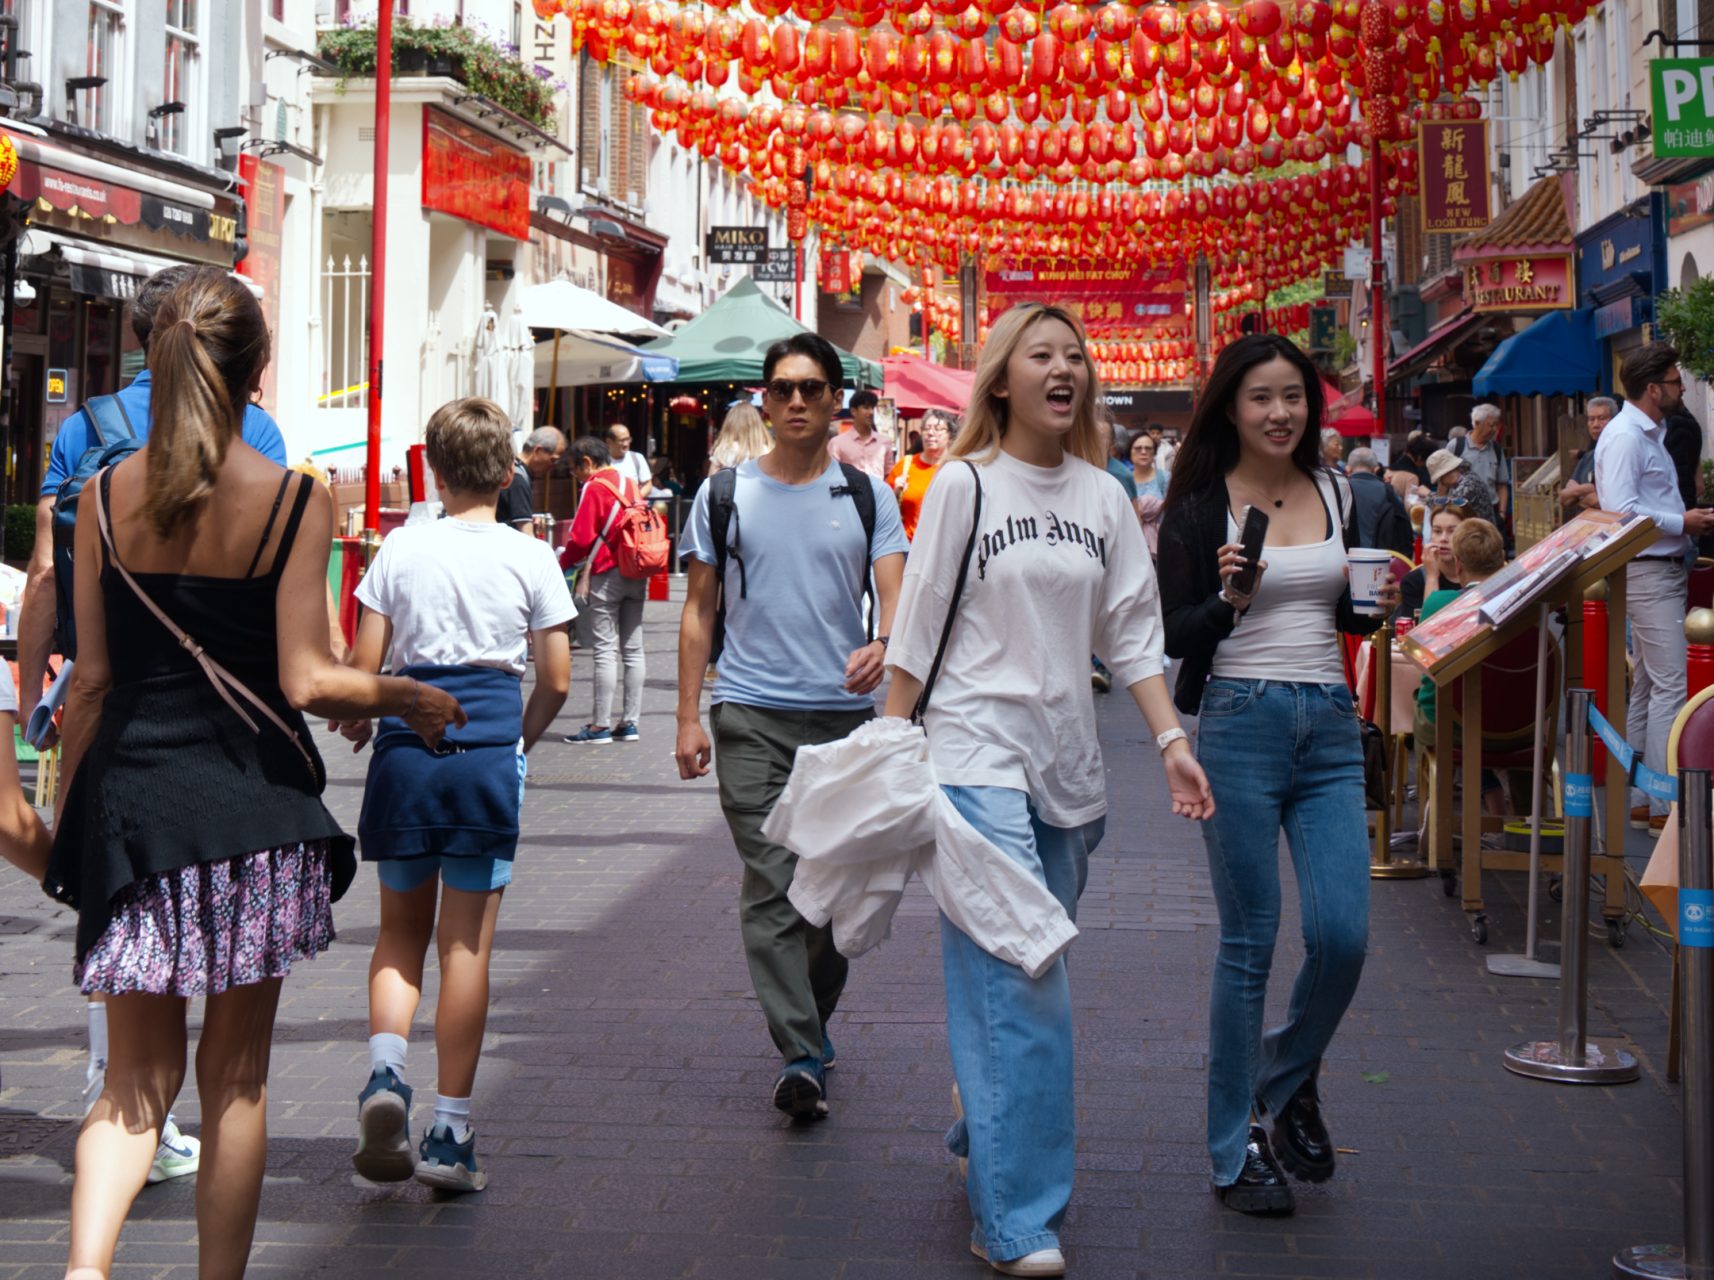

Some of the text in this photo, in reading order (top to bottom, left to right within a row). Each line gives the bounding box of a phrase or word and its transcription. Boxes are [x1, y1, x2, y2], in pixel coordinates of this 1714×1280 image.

[1446, 207, 1472, 217] NEW
[1428, 216, 1488, 228] LOON FUNG
[220, 216, 237, 243] POT
[714, 229, 765, 245] MIKO
[714, 243, 764, 252] HAIR SALON
[1085, 270, 1104, 281] FAT
[1474, 284, 1561, 306] RESTAURANT
